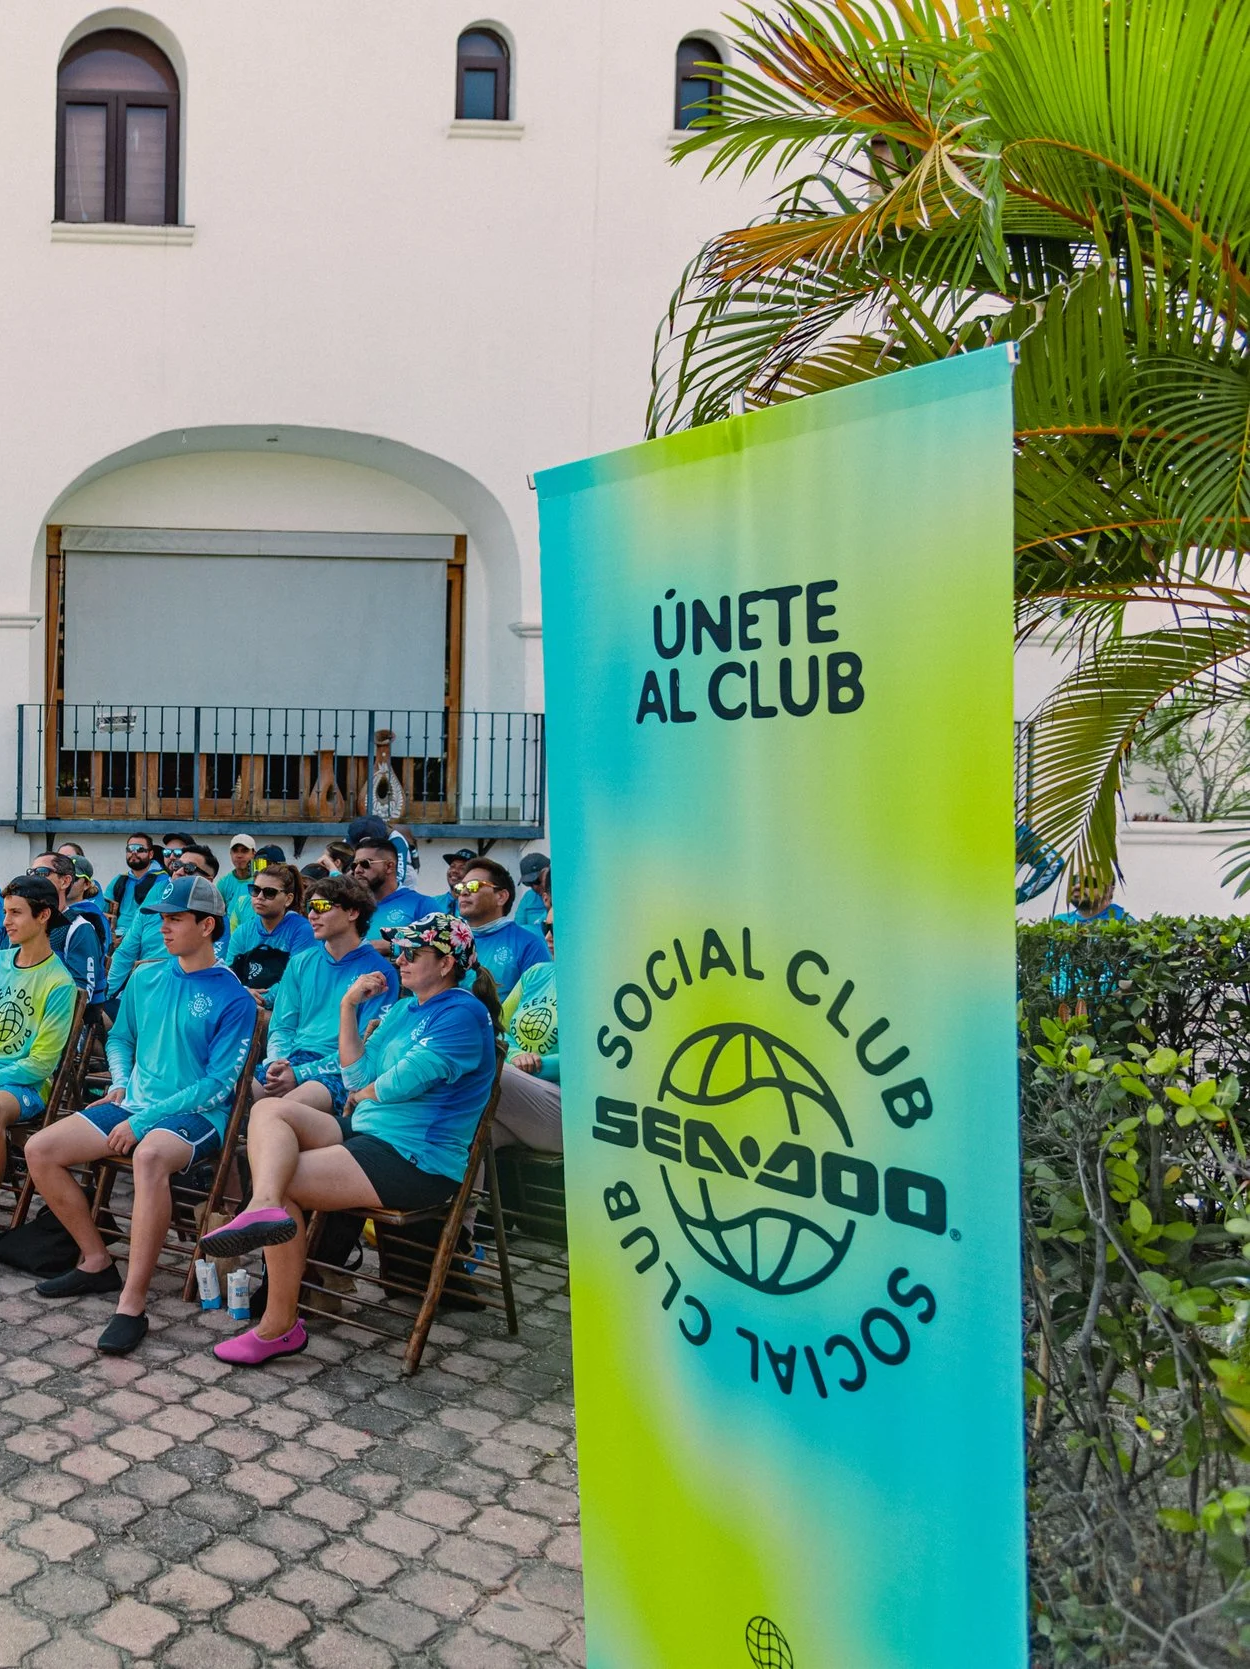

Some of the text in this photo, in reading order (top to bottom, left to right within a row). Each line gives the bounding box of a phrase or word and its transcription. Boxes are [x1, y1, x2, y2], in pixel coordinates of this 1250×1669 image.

[636, 651, 865, 724] AL CLUB
[653, 579, 839, 660] ÚNETE
[597, 926, 933, 1129] SOCIAL CLUB
[603, 1180, 937, 1399] SOCIAL CLUB
